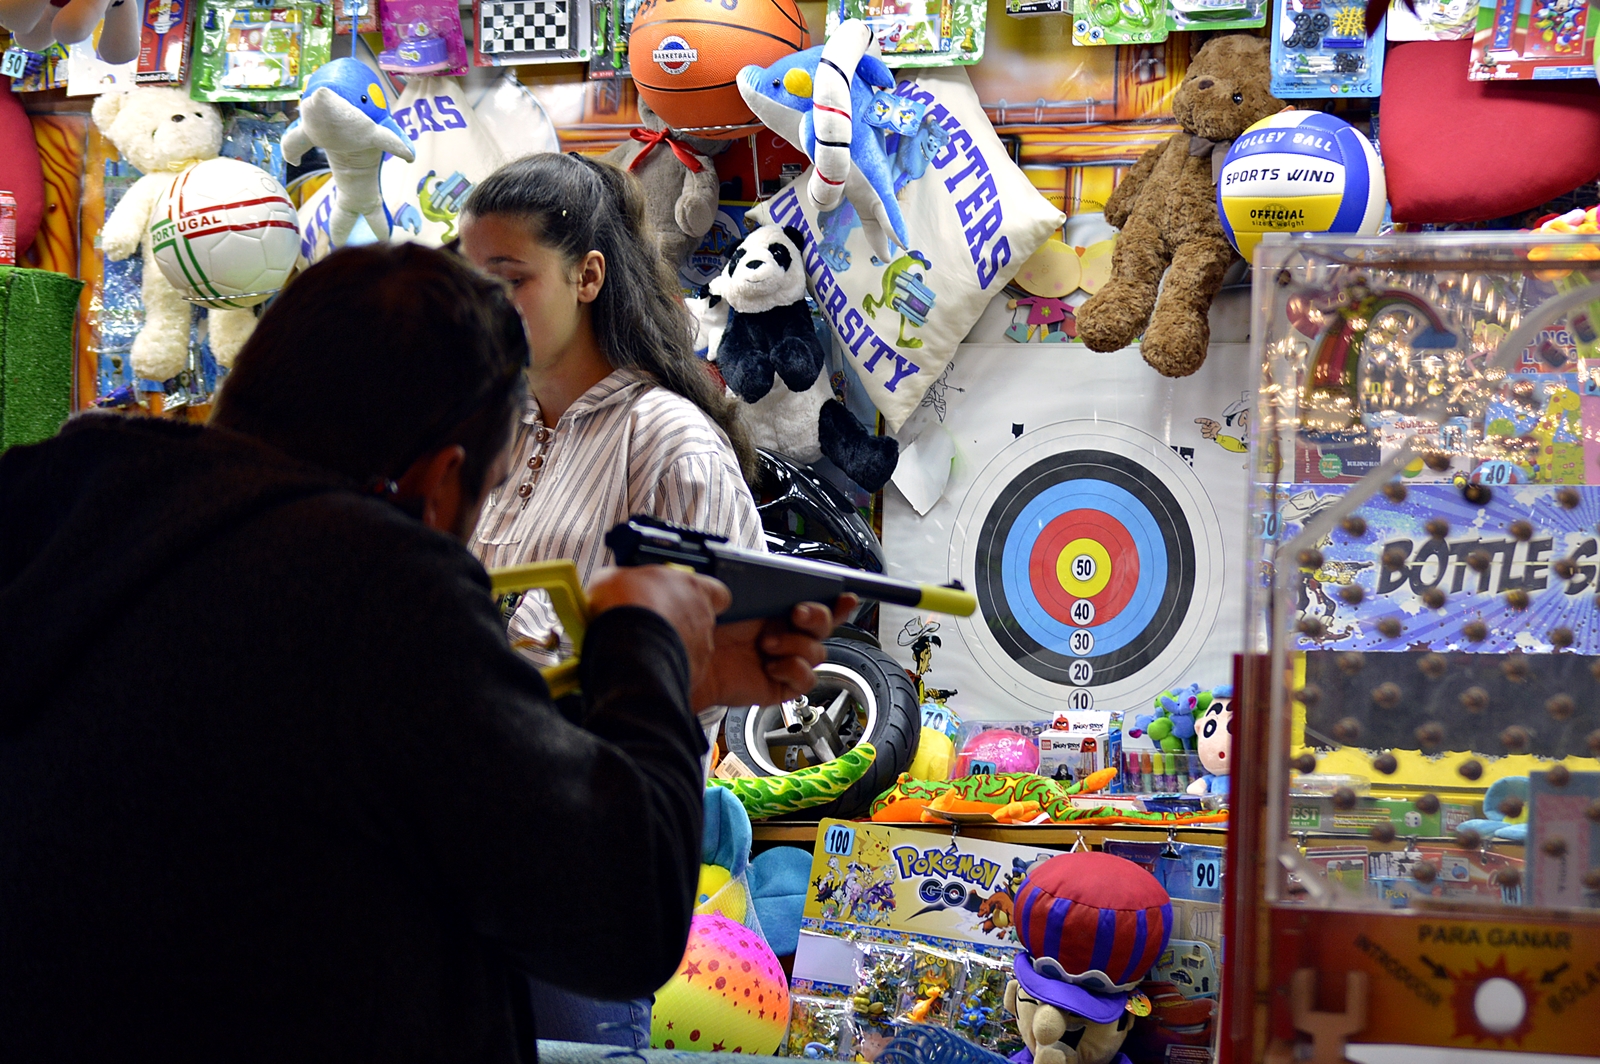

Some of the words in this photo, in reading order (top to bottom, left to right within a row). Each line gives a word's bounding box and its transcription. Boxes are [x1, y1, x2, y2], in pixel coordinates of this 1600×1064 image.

[5, 53, 22, 74] 50
[1234, 131, 1286, 154] VOLLEY
[1292, 132, 1332, 152] BALL
[1226, 168, 1280, 185] SPORTS
[1287, 169, 1335, 183] WIND
[1250, 209, 1304, 219] OFFICIAL
[152, 213, 222, 246] PORTUGAL
[691, 256, 723, 266] PATROL
[1485, 464, 1505, 485] 40
[1076, 559, 1092, 576] 50
[1376, 537, 1553, 596] BOTTLE
[1074, 603, 1090, 620] 40
[1074, 633, 1090, 650] 30
[1073, 663, 1089, 680] 20
[1072, 693, 1088, 709] 10
[923, 711, 944, 729] 70
[830, 829, 850, 854] 100
[1196, 863, 1215, 887] 90
[919, 878, 967, 907] GO
[1417, 924, 1481, 944] PARA
[1487, 928, 1572, 949] GANAR
[926, 954, 948, 968] GO
